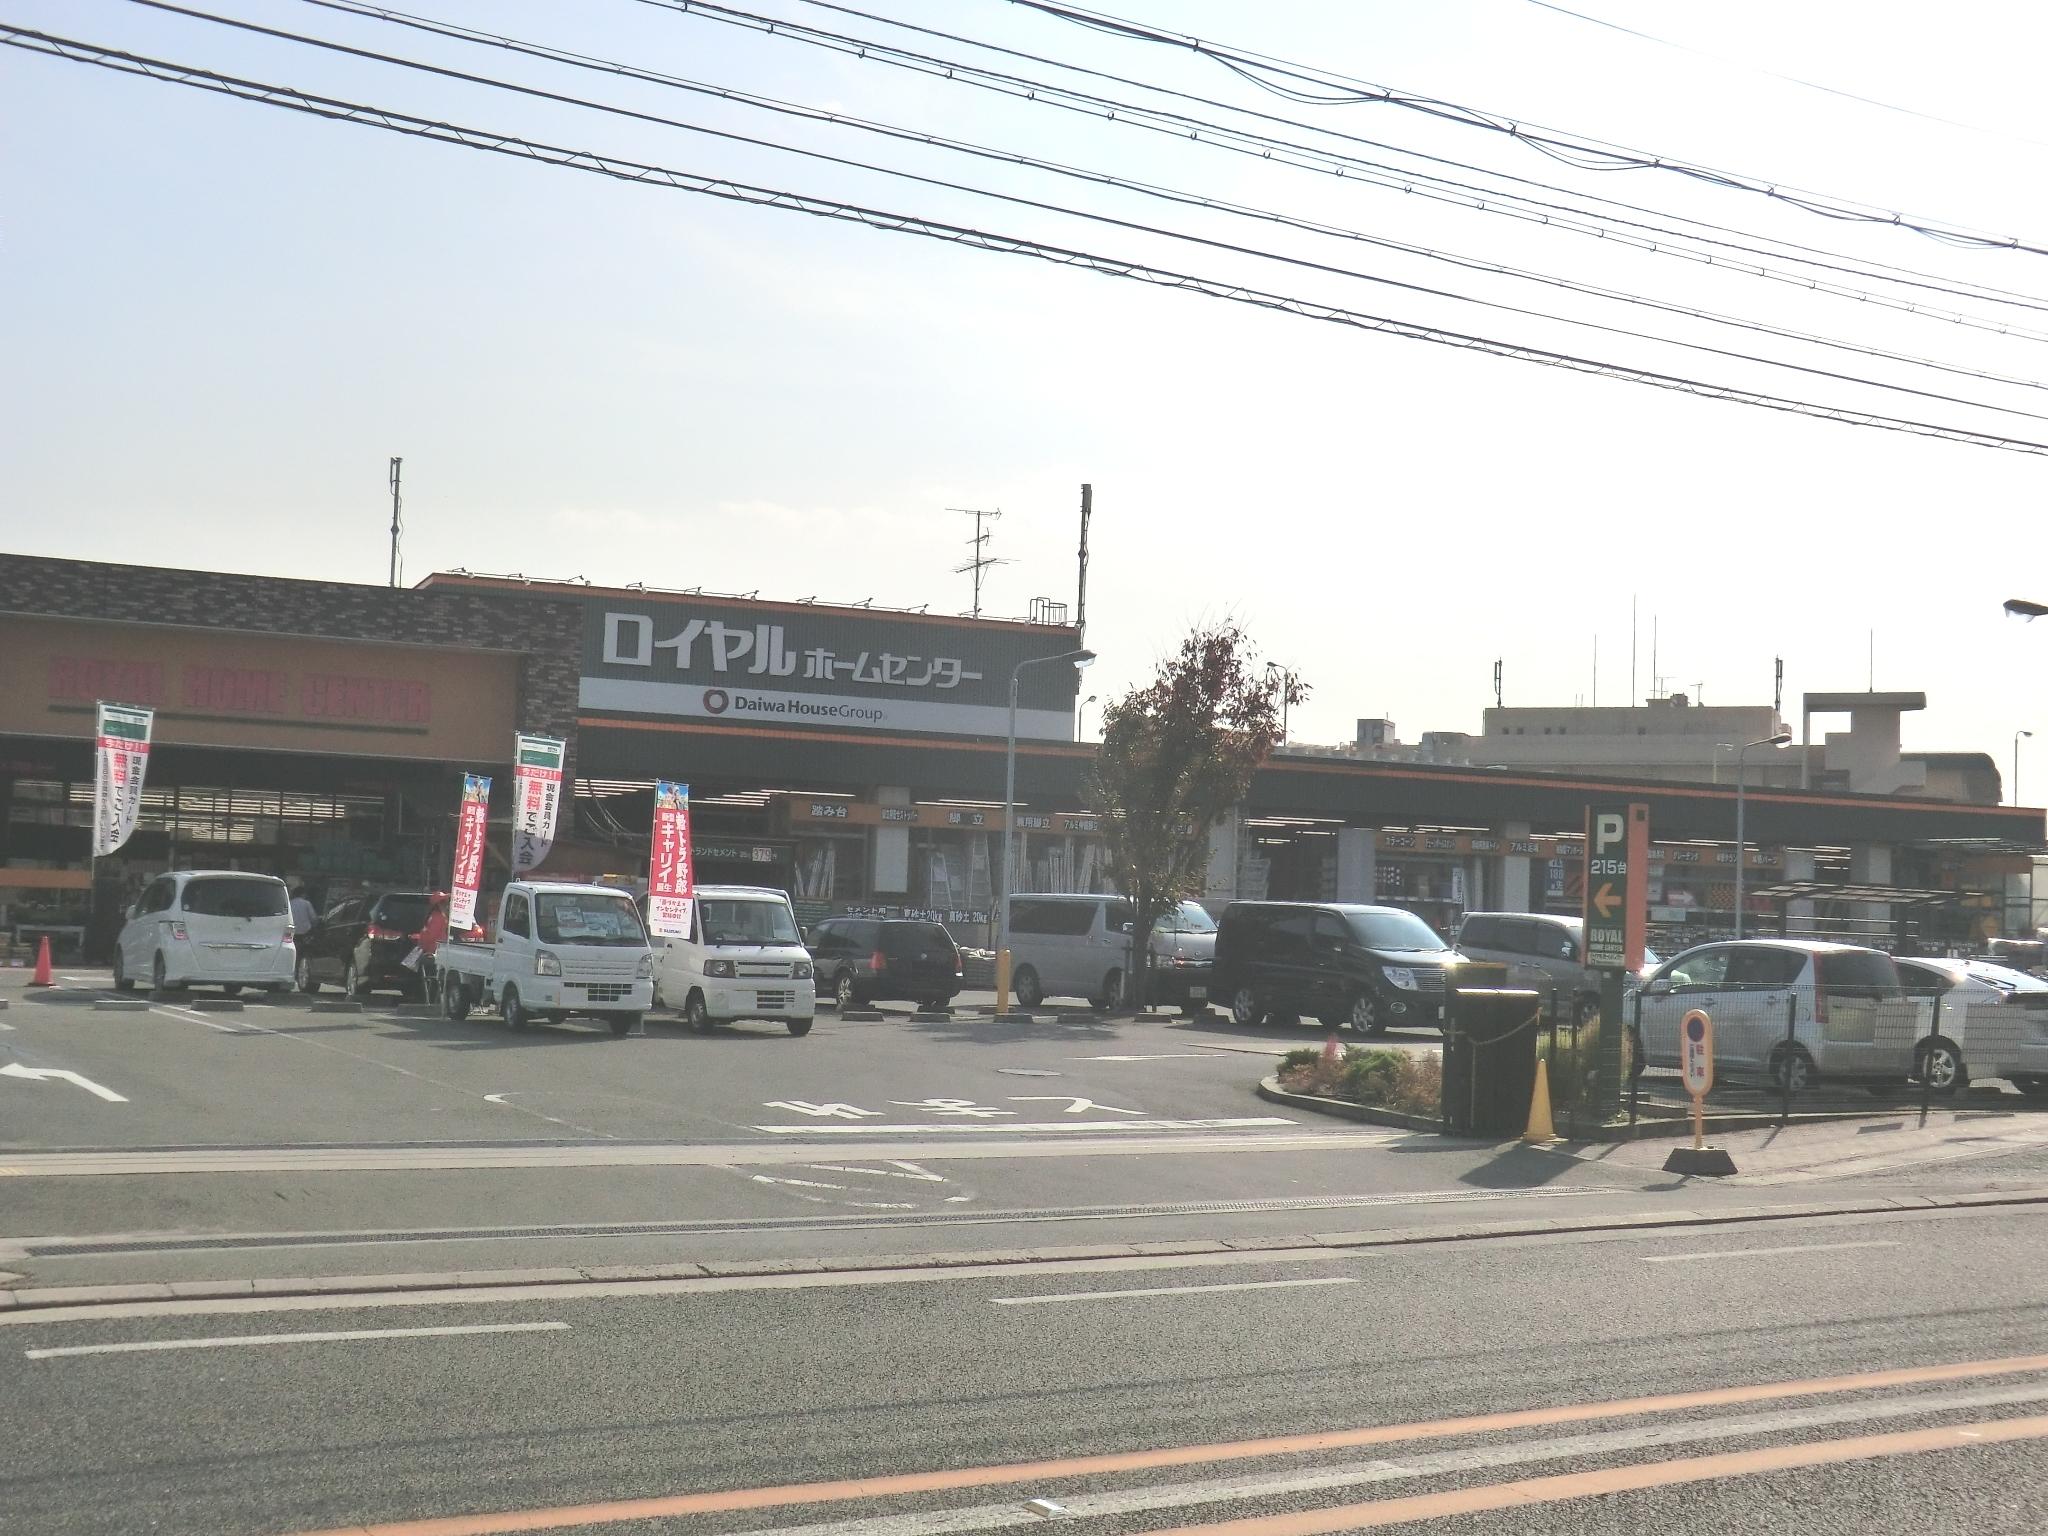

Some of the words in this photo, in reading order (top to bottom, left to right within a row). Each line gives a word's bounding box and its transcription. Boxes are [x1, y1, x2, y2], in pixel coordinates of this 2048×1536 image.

[602, 612, 797, 677] ロイヤル
[803, 647, 983, 688] ホームセンター
[519, 780, 543, 865] 無料でご入会
[541, 782, 556, 847] 現金会員カード
[811, 804, 848, 818] 踏み台
[1597, 814, 1624, 855] P
[675, 812, 688, 896] 軽トラ野郎
[1591, 859, 1627, 875] 215台
[1591, 929, 1623, 943] ROYAL
